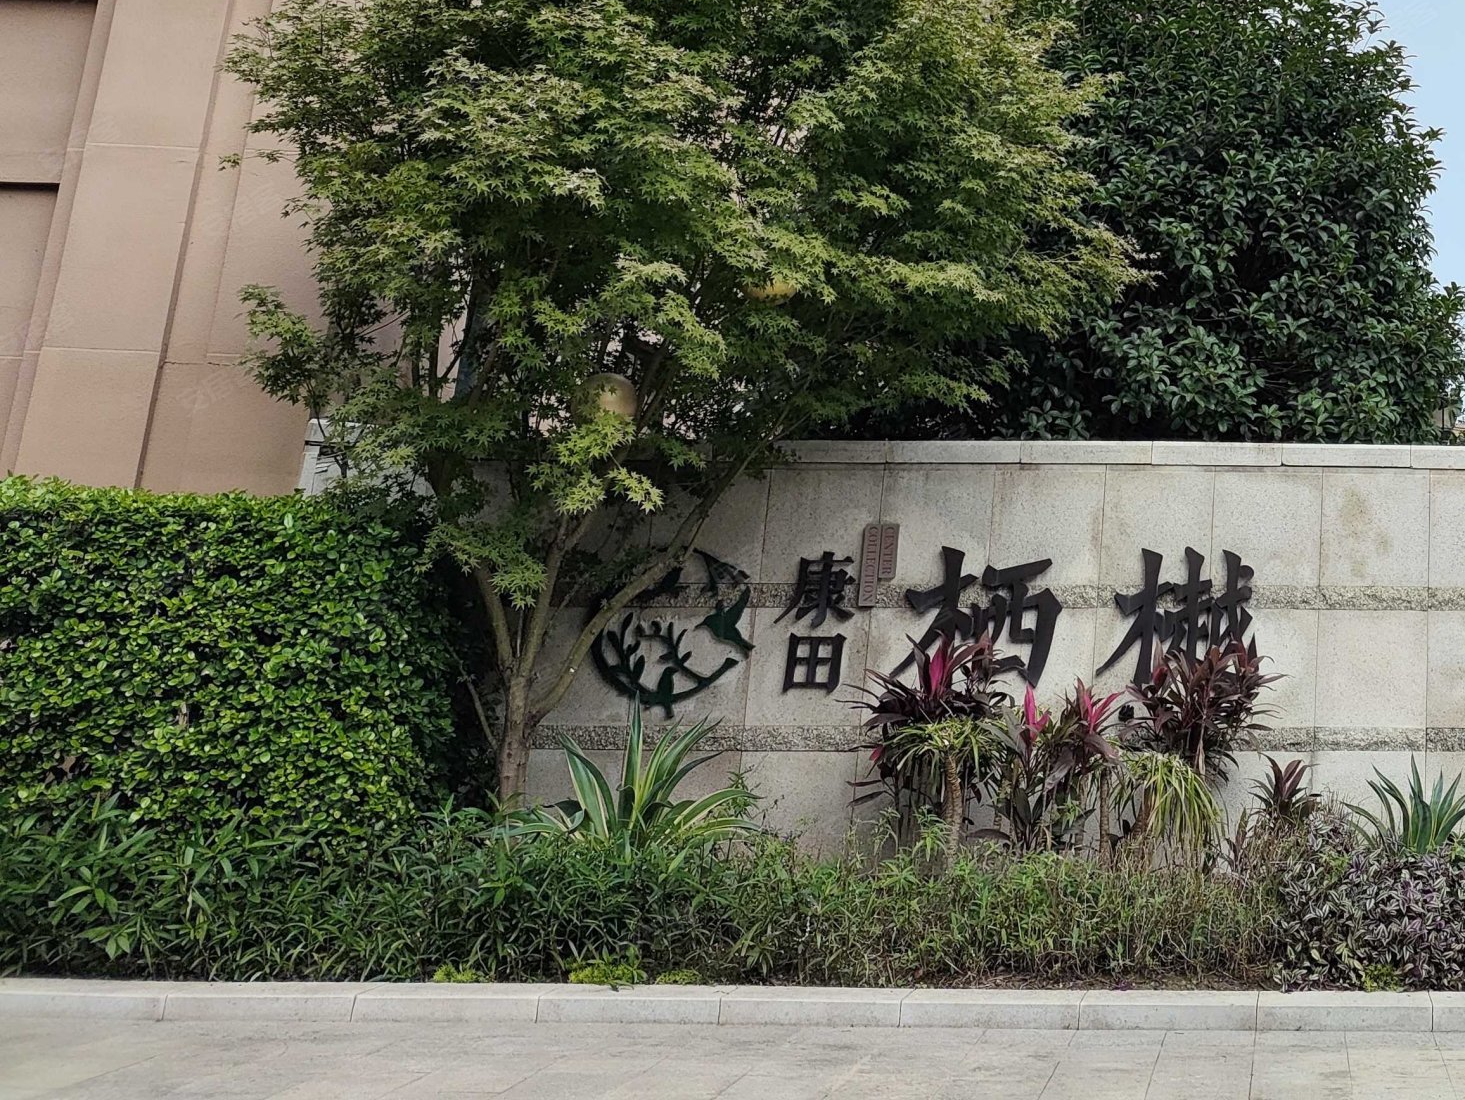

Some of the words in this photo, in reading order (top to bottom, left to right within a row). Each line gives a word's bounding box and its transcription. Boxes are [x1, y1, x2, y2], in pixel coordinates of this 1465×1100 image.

[863, 526, 879, 602] COLLECTION
[881, 526, 895, 575] CENTER
[773, 551, 856, 694] 康田
